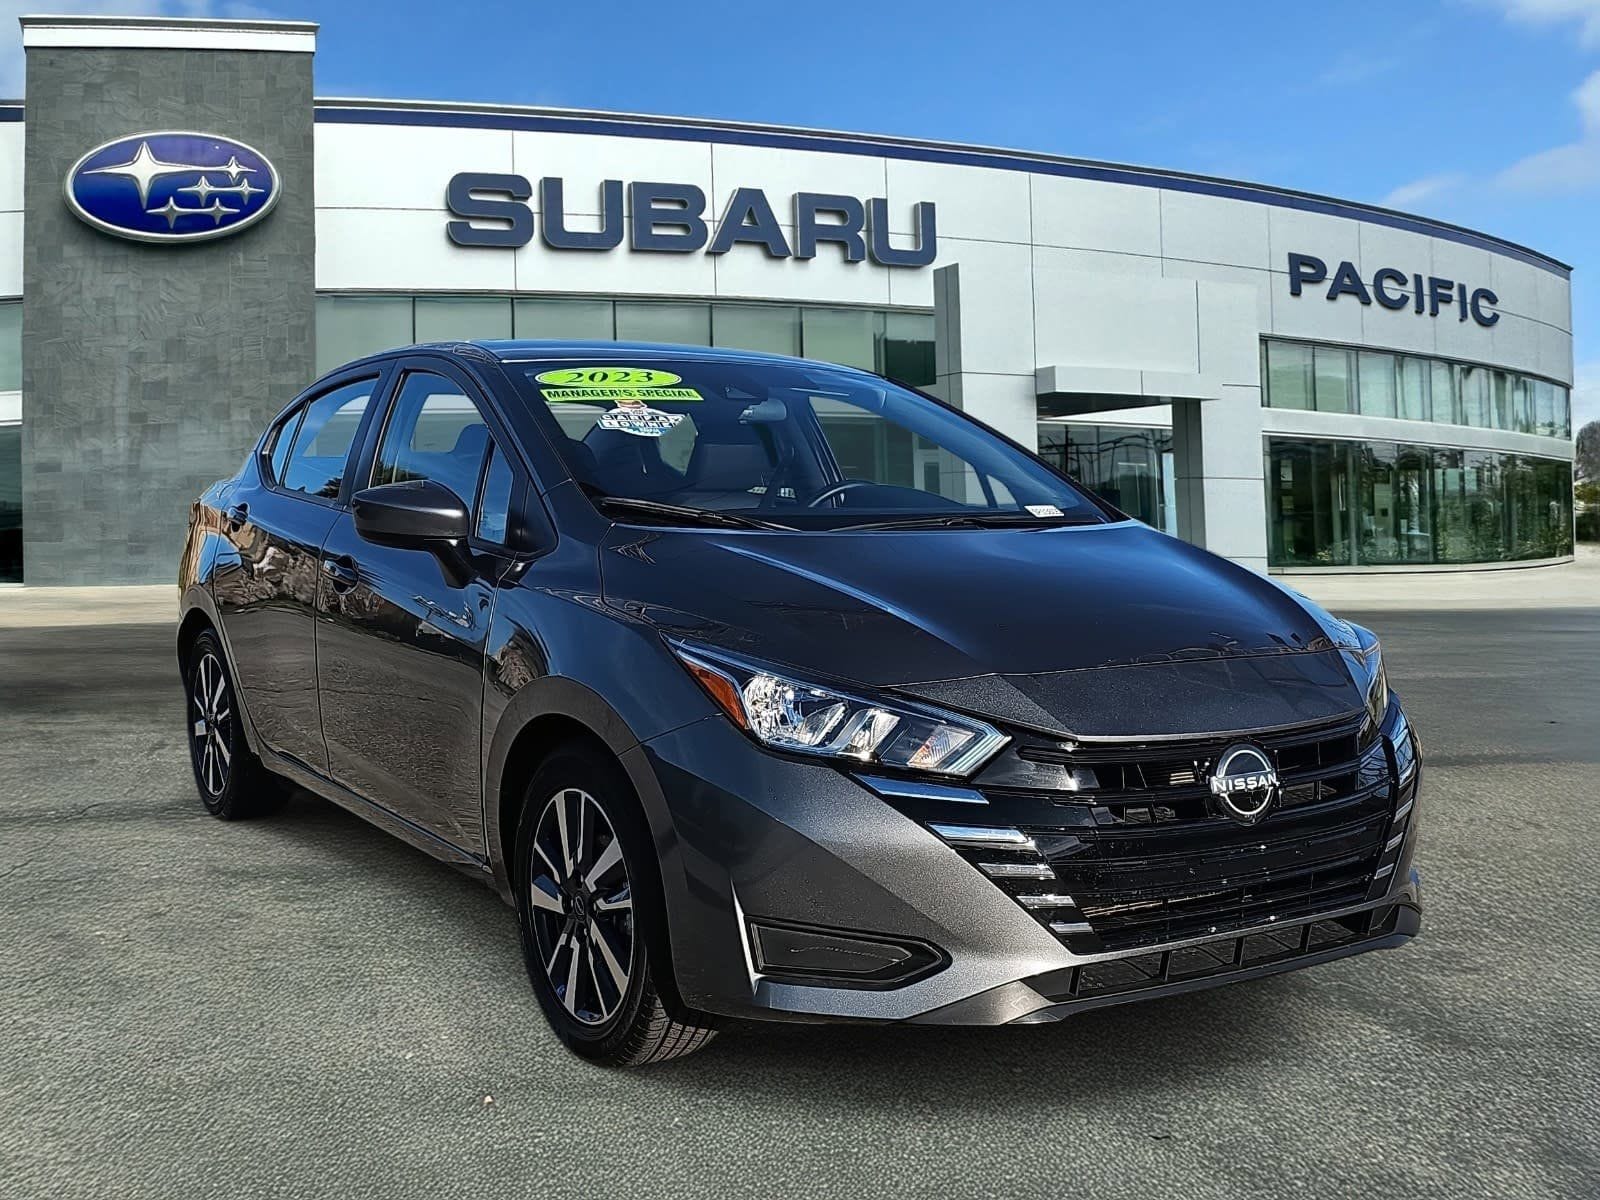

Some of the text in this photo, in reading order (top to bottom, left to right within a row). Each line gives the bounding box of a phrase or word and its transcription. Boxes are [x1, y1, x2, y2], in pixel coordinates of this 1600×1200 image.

[447, 172, 937, 267] SUBARU
[1288, 252, 1500, 327] PACIFIC
[564, 371, 654, 383] 2023
[547, 388, 695, 398] MANAGER'S SPECIAL
[1211, 772, 1278, 793] NISSAN
